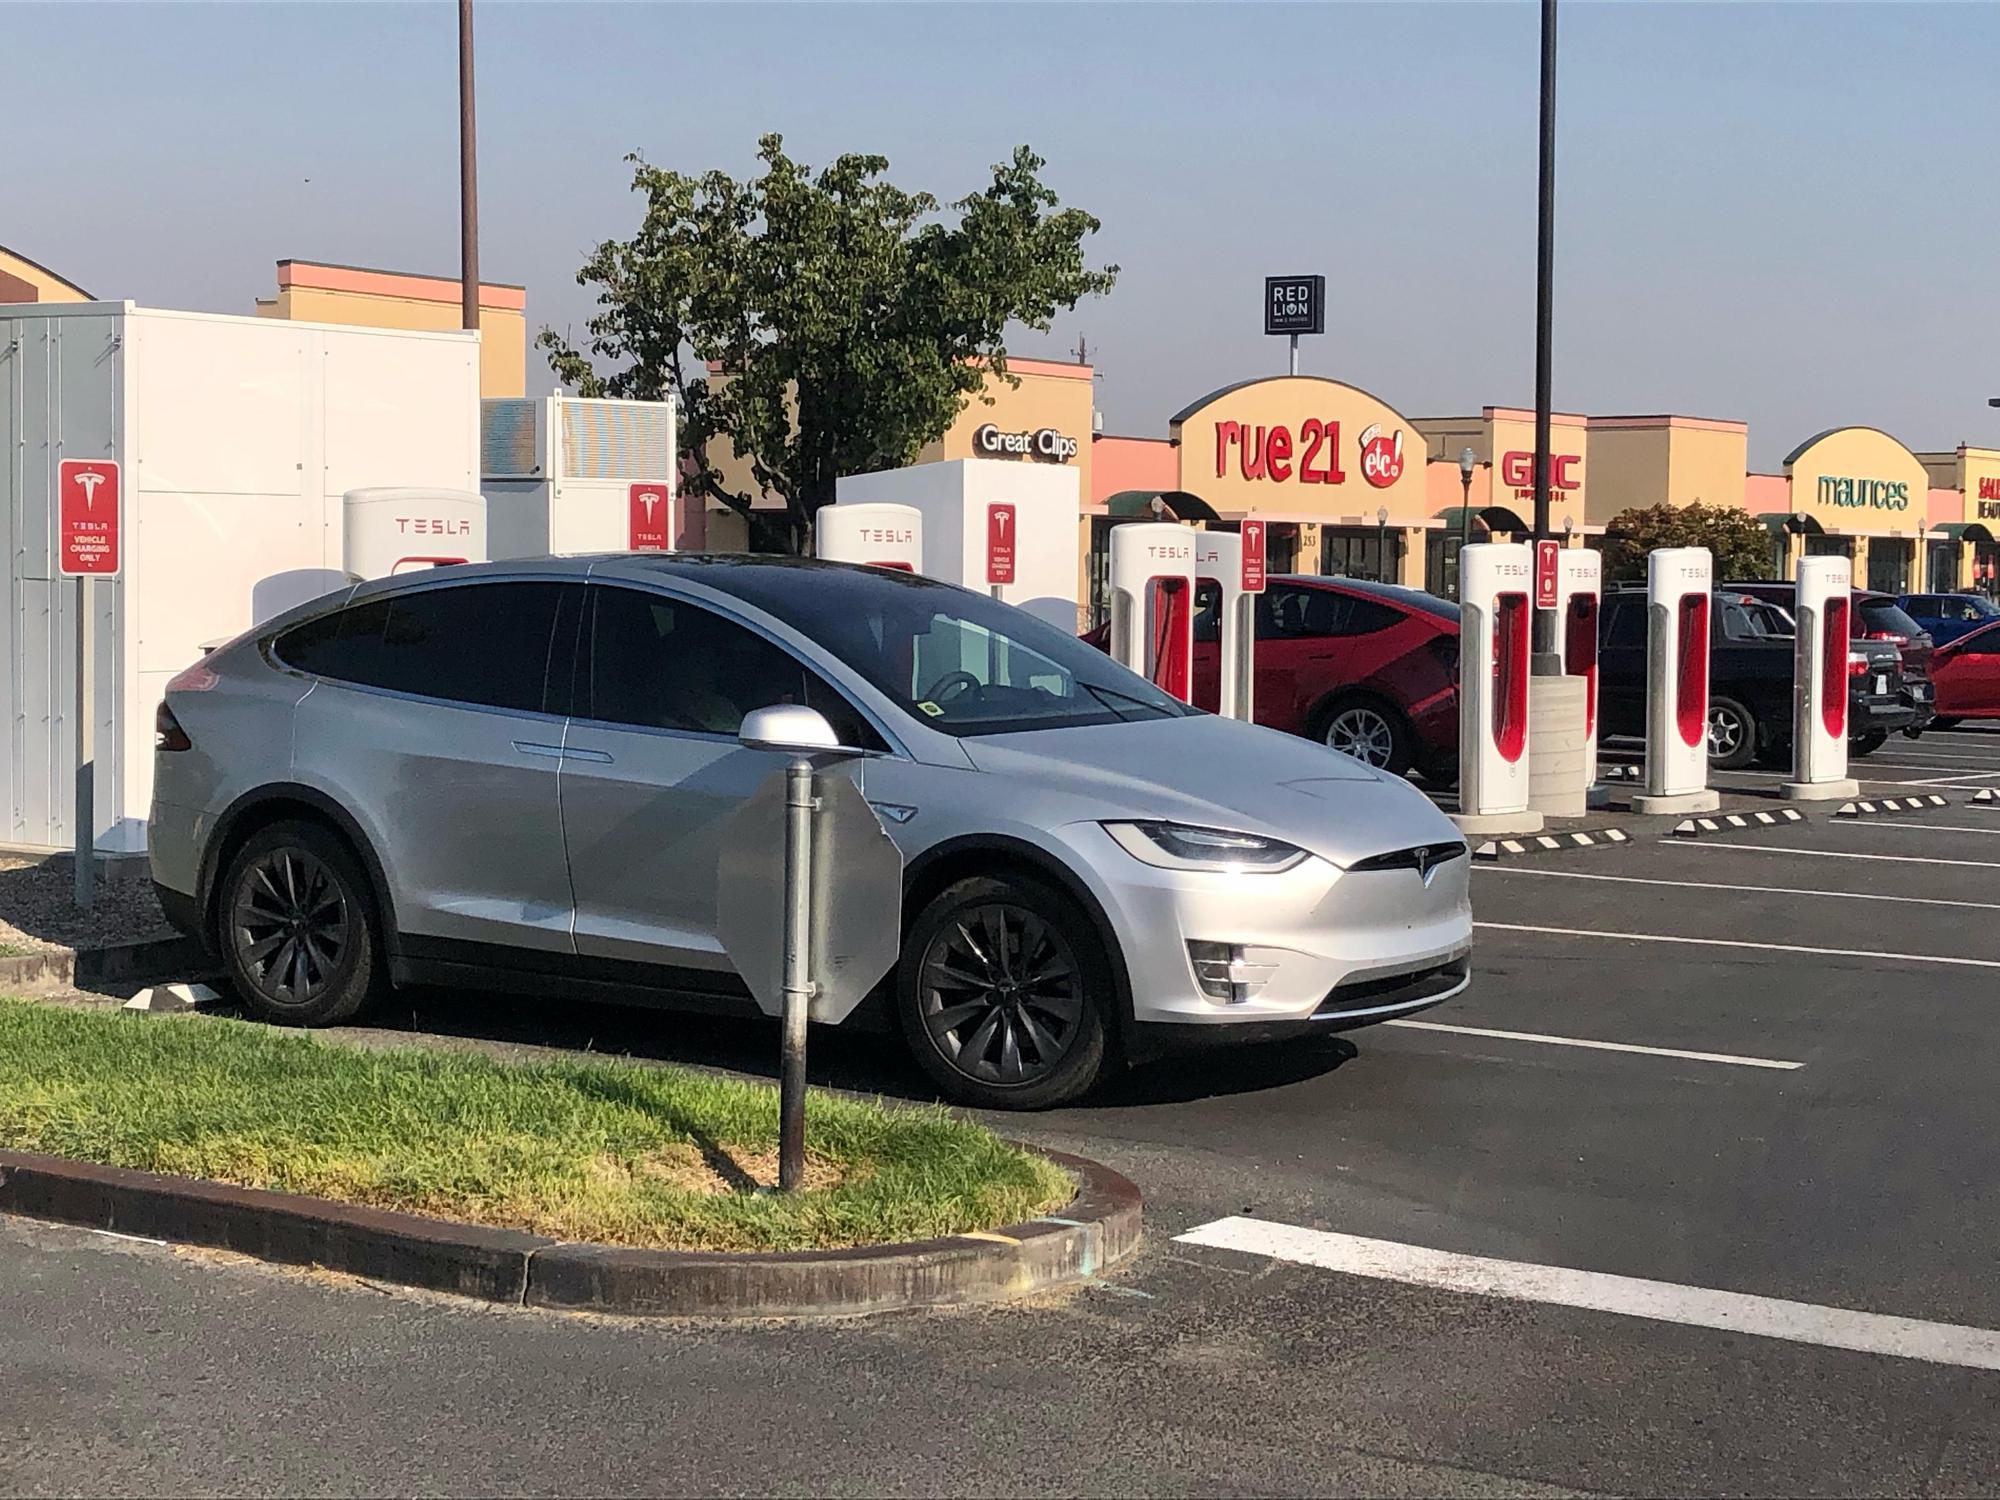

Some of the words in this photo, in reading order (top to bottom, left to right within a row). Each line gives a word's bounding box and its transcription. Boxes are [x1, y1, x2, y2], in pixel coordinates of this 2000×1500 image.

[1274, 286, 1308, 301] RED
[1274, 303, 1307, 316] LION
[981, 424, 1032, 453] Great
[1038, 429, 1077, 462] Clips
[1818, 475, 1909, 511] maurices
[72, 522, 108, 530] TESLA
[395, 518, 470, 535] TESLA
[637, 533, 662, 541] TESLA
[859, 529, 912, 543] TESLA
[79, 554, 101, 562] ONLY
[1148, 546, 1189, 559] TESLA
